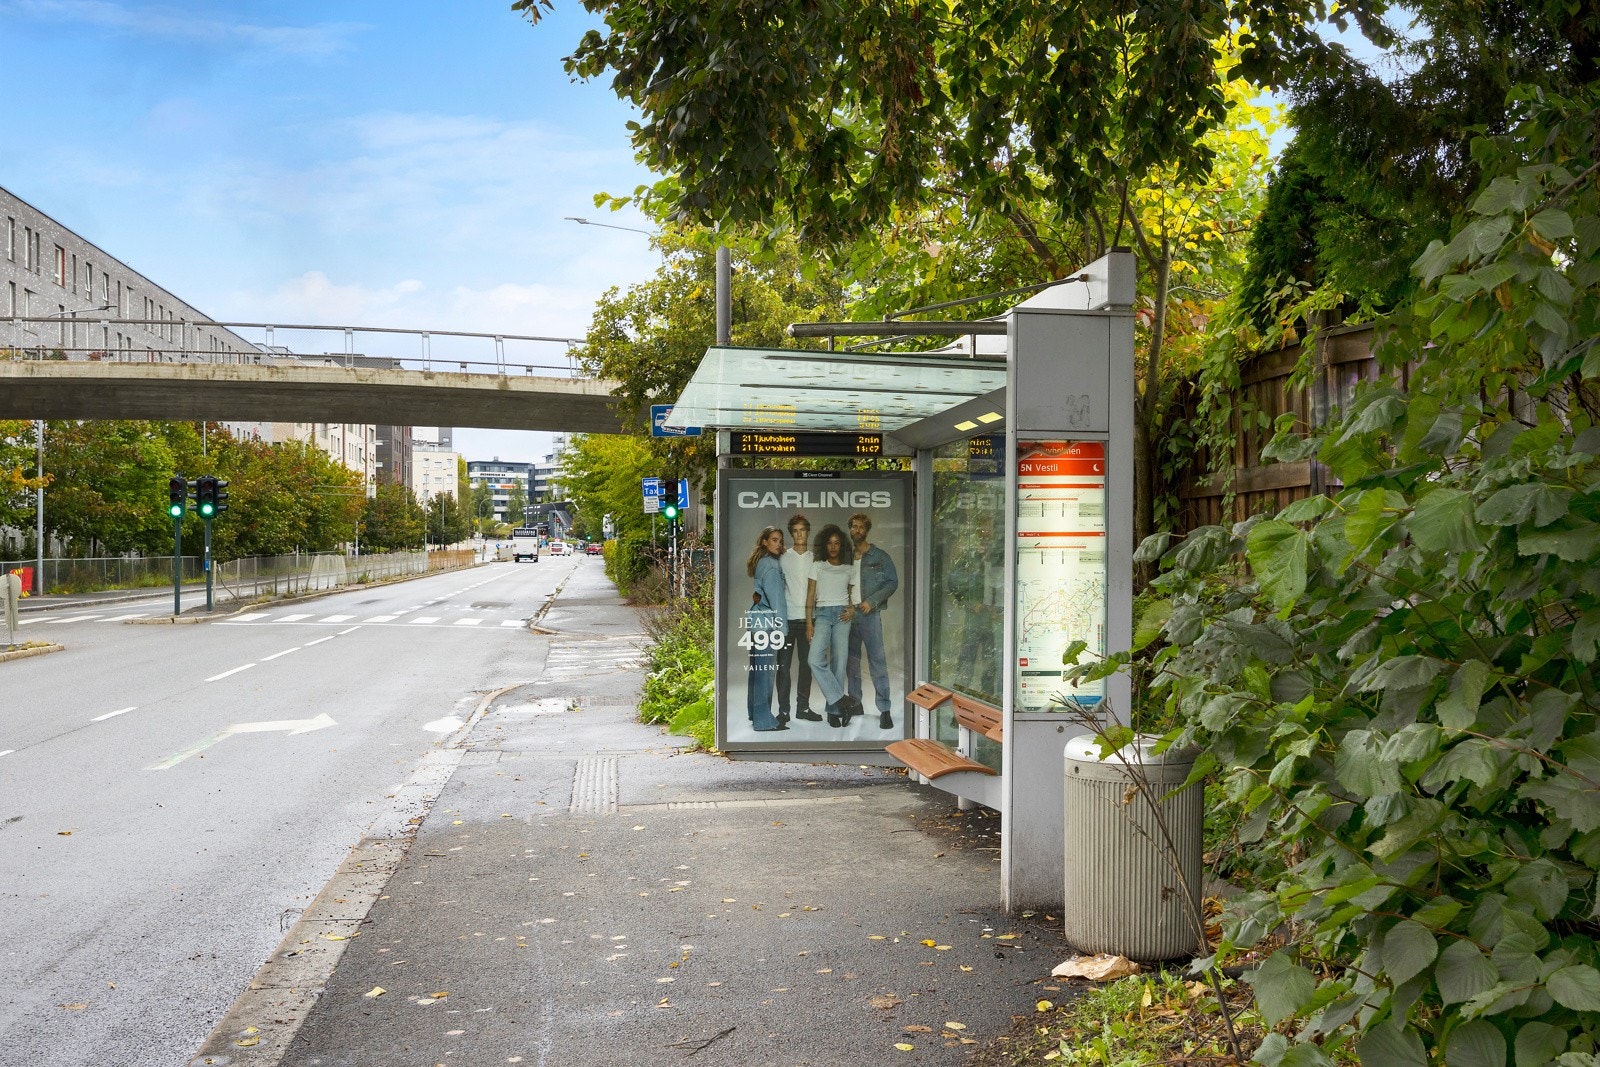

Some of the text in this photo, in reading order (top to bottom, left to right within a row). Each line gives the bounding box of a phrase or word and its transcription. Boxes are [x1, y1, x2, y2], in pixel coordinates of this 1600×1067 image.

[1036, 446, 1081, 456] uvholmen
[738, 491, 891, 508] CARLINGS
[738, 616, 784, 628] JEANS
[738, 630, 792, 650] 499.-
